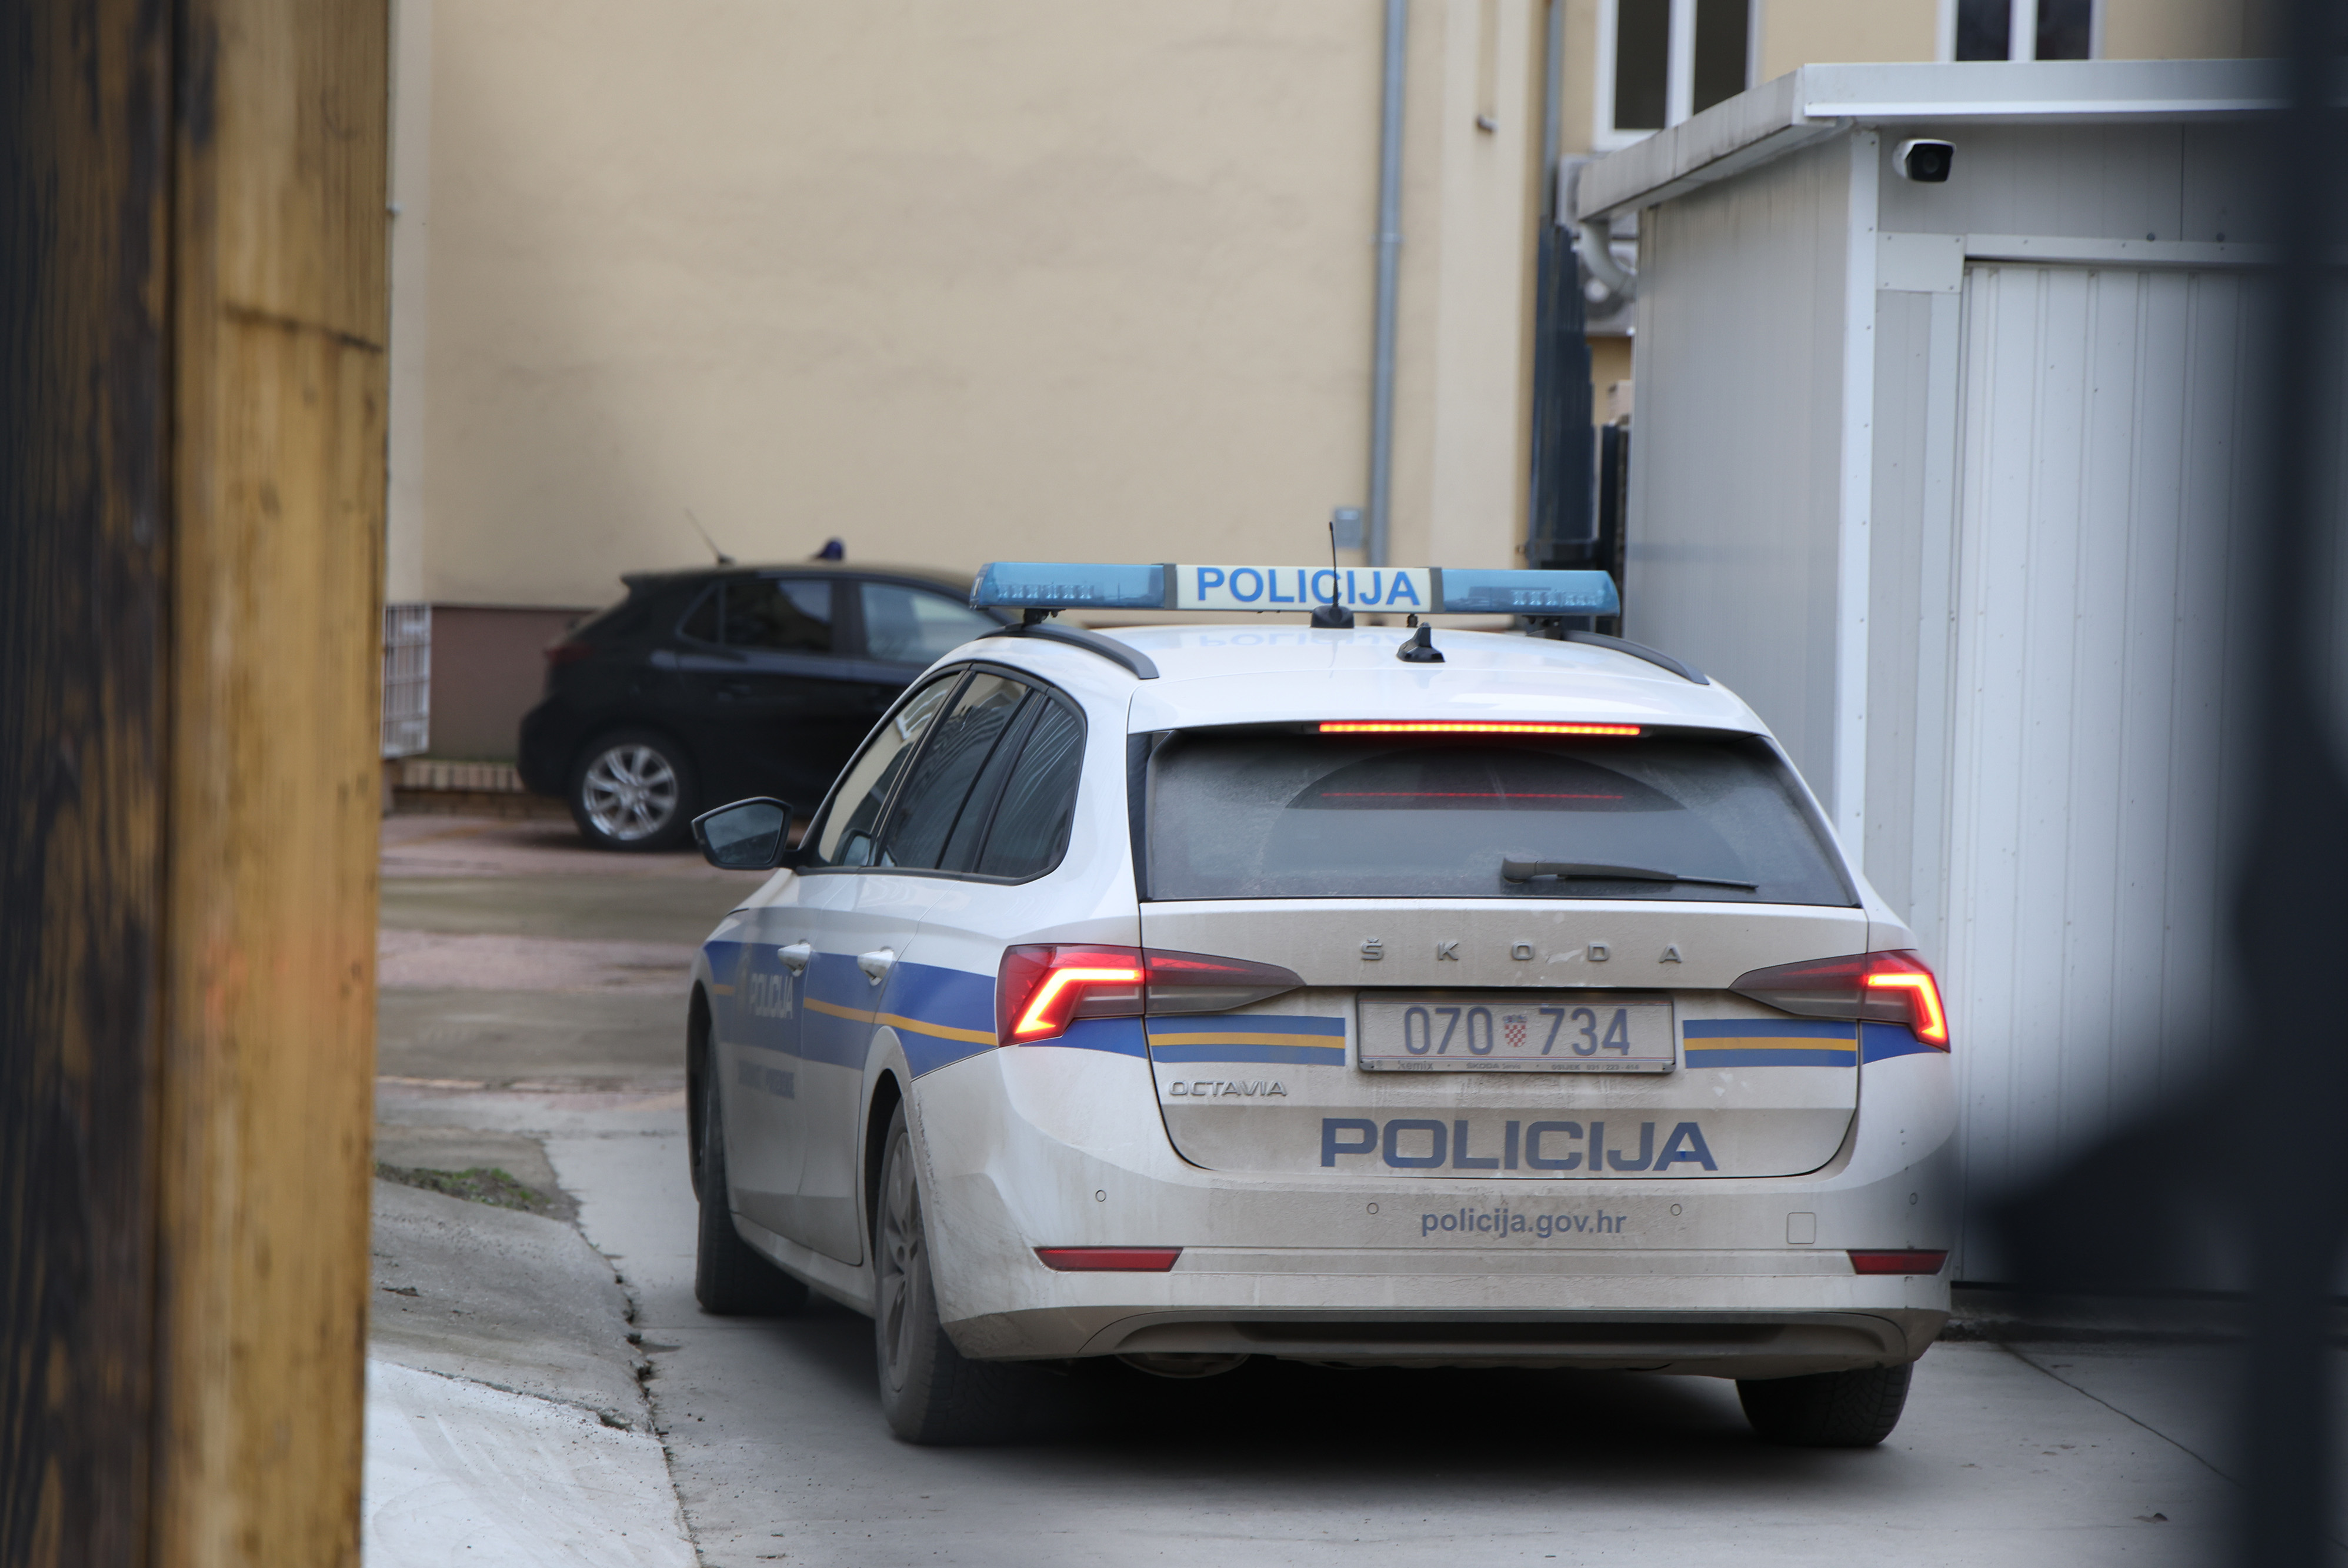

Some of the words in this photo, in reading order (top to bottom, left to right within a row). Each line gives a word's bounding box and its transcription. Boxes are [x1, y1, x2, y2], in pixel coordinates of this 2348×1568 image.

[1196, 566, 1420, 606] POLICIJA
[1360, 939, 1682, 963] ŠKODA
[1404, 1006, 1493, 1055] 070
[1539, 1007, 1630, 1056] 734
[1168, 1080, 1288, 1096] OCTAVIA
[1320, 1117, 1719, 1172] POLICIJA
[1421, 1208, 1627, 1237] policija.gov.hr
